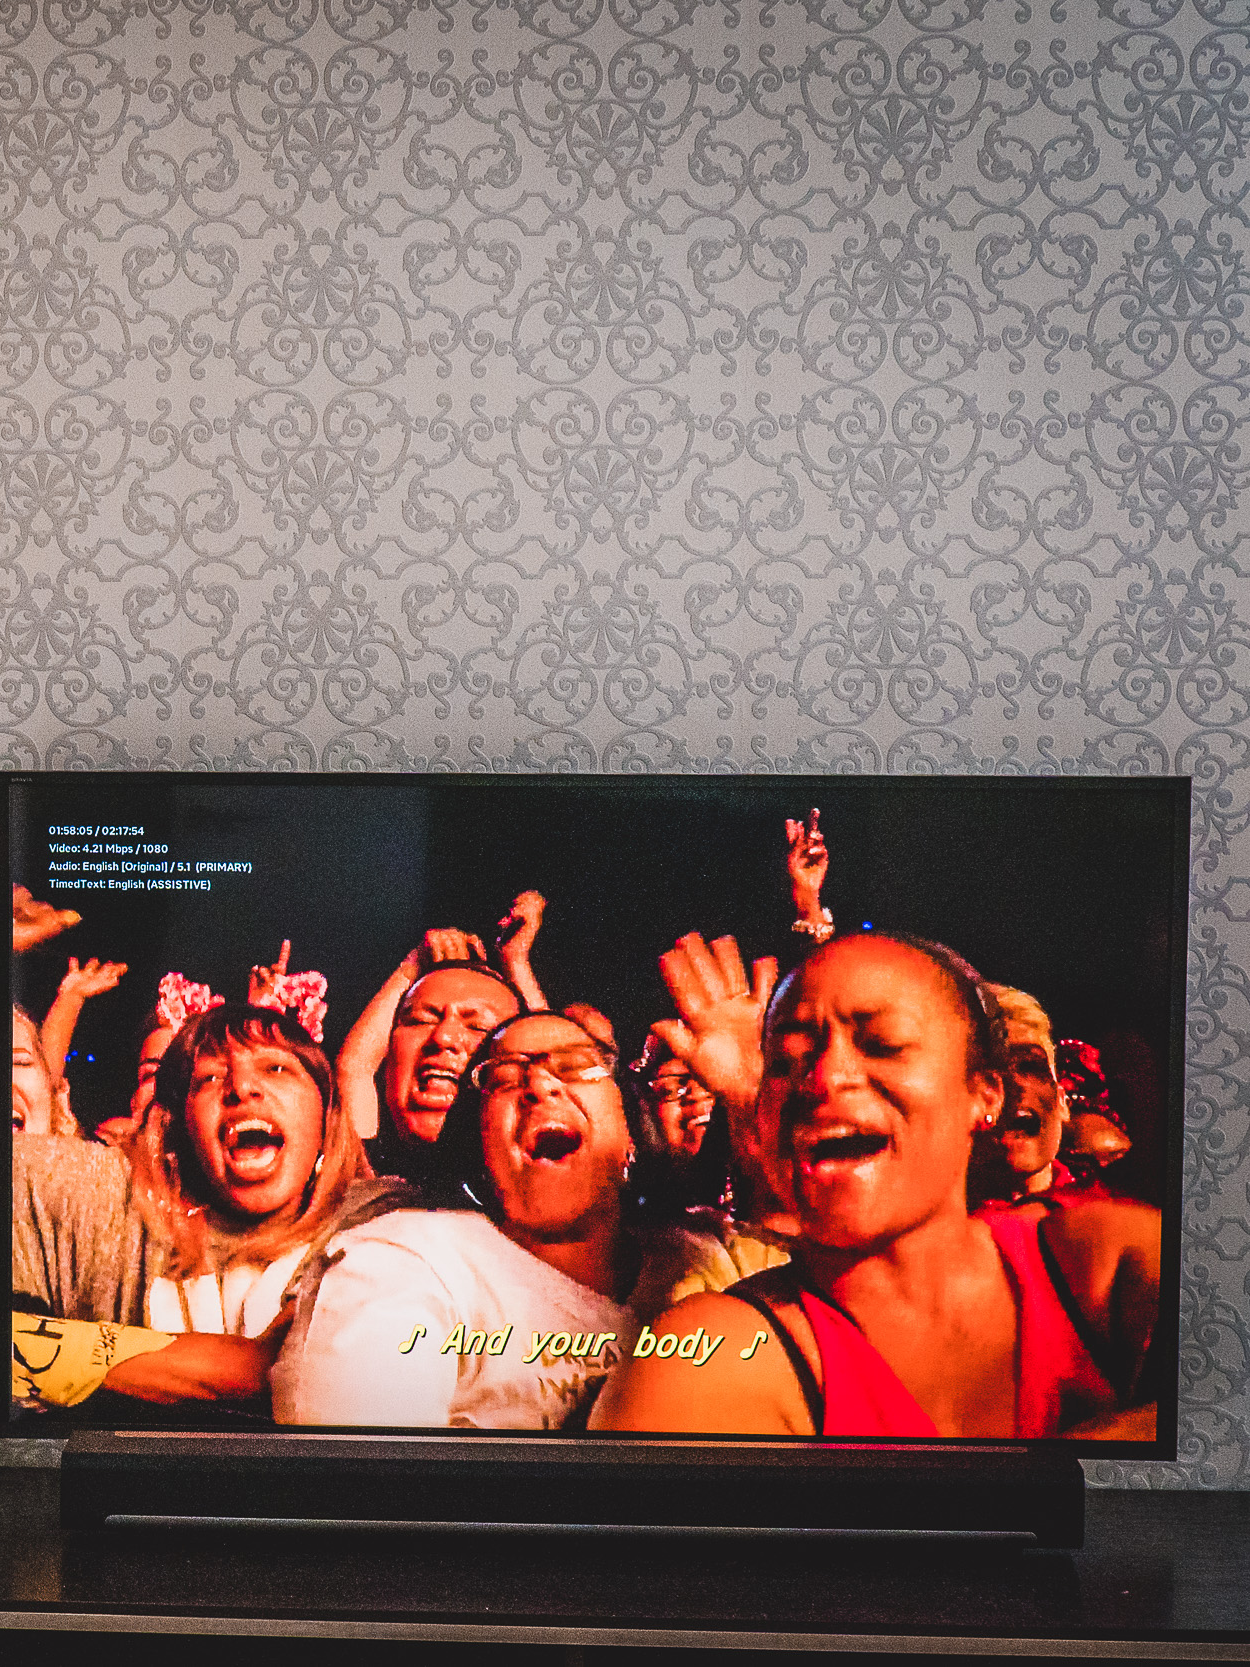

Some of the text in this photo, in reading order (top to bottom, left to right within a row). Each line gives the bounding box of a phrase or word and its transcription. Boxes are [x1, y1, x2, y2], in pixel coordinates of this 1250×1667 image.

[48, 825, 93, 836] 01:58:05
[102, 825, 145, 836] 02:17:54
[48, 843, 81, 854] Video:
[82, 844, 103, 854] 4.21
[105, 844, 134, 856] Mbps
[142, 844, 169, 855] 1080
[48, 861, 81, 872] Audio:
[82, 861, 119, 874] English
[121, 861, 168, 874] [Original]
[177, 862, 191, 873] 5.1
[195, 862, 253, 875] (PRIMARY)
[48, 879, 212, 892] TimedText: English (ASSISTIVE)
[439, 1322, 725, 1367] And your body
